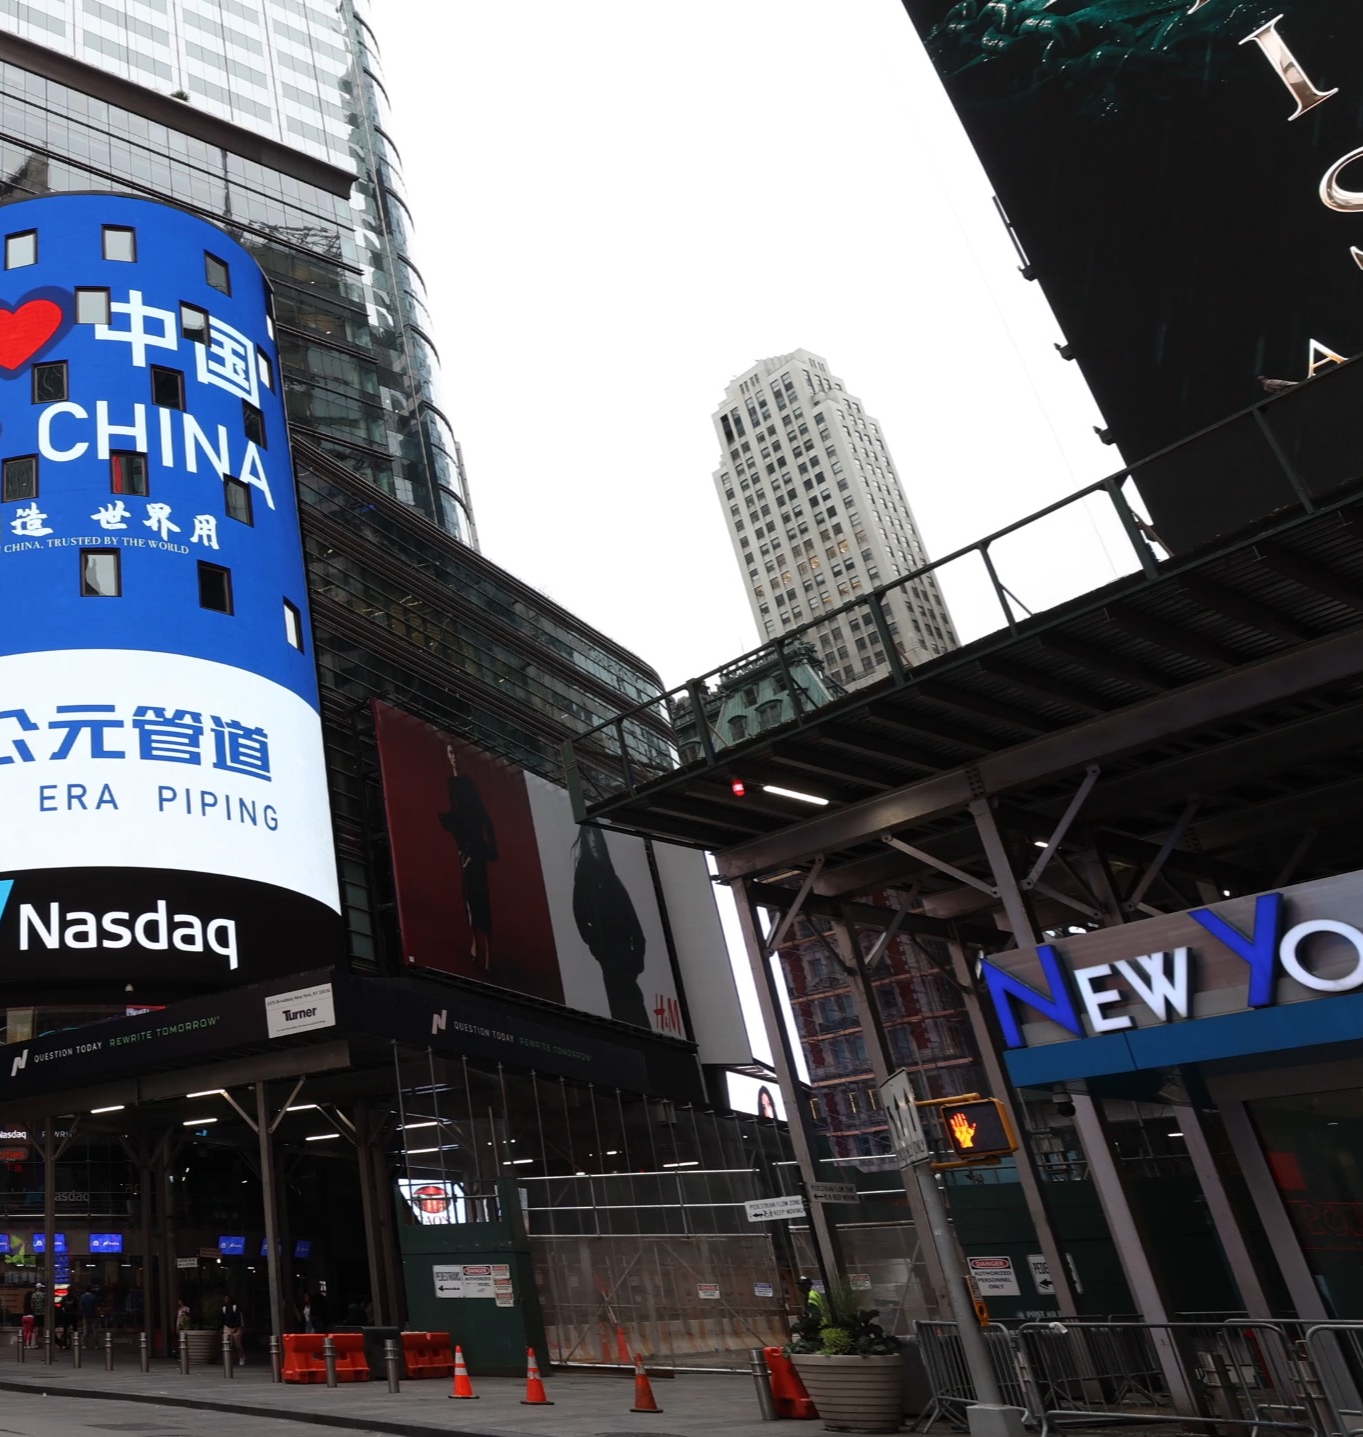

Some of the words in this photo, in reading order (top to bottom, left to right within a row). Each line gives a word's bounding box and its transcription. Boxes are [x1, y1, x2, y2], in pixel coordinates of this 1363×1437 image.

[95, 290, 260, 408] 中国
[39, 401, 275, 511] CHINA
[47, 536, 101, 548] TRUSTED
[104, 536, 119, 546] BY
[121, 537, 146, 548] THE
[148, 540, 190, 555] WORLD
[90, 500, 220, 550] 世界用
[39, 783, 119, 812] ERA
[157, 785, 279, 832] PIPING
[19, 900, 239, 970] Nasdaq
[282, 1007, 317, 1021] Turner
[453, 1020, 490, 1037] QUESTION
[492, 1030, 515, 1044] TODAY
[519, 1036, 552, 1052] REWRITE
[653, 993, 681, 1037] H&M
[34, 1048, 73, 1063] QUESTION
[76, 1041, 103, 1057] TODAY
[109, 1030, 153, 1047] REWRITE
[749, 1202, 776, 1210] PEDESTRIAN
[788, 1199, 802, 1207] ZONE
